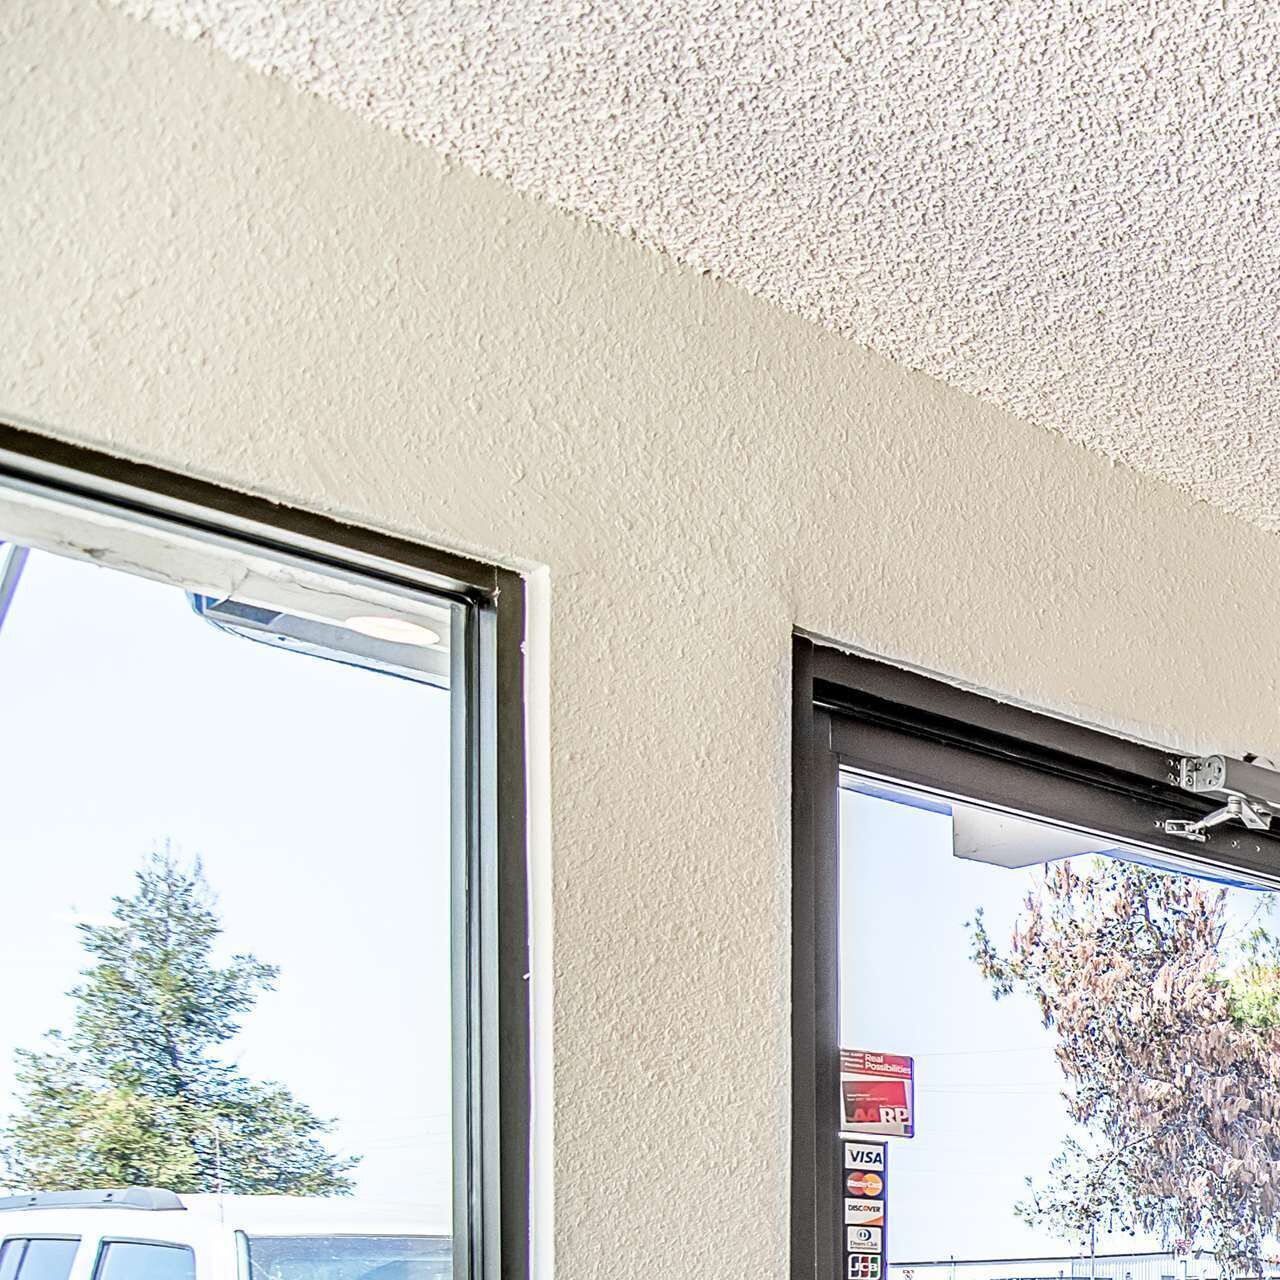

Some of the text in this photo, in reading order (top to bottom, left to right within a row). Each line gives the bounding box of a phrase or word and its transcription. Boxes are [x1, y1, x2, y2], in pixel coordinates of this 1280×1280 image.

[865, 1054, 883, 1063] Real
[853, 1107, 909, 1123] AARP
[848, 1149, 882, 1165] VISA
[848, 1204, 880, 1213] DISCOVER
